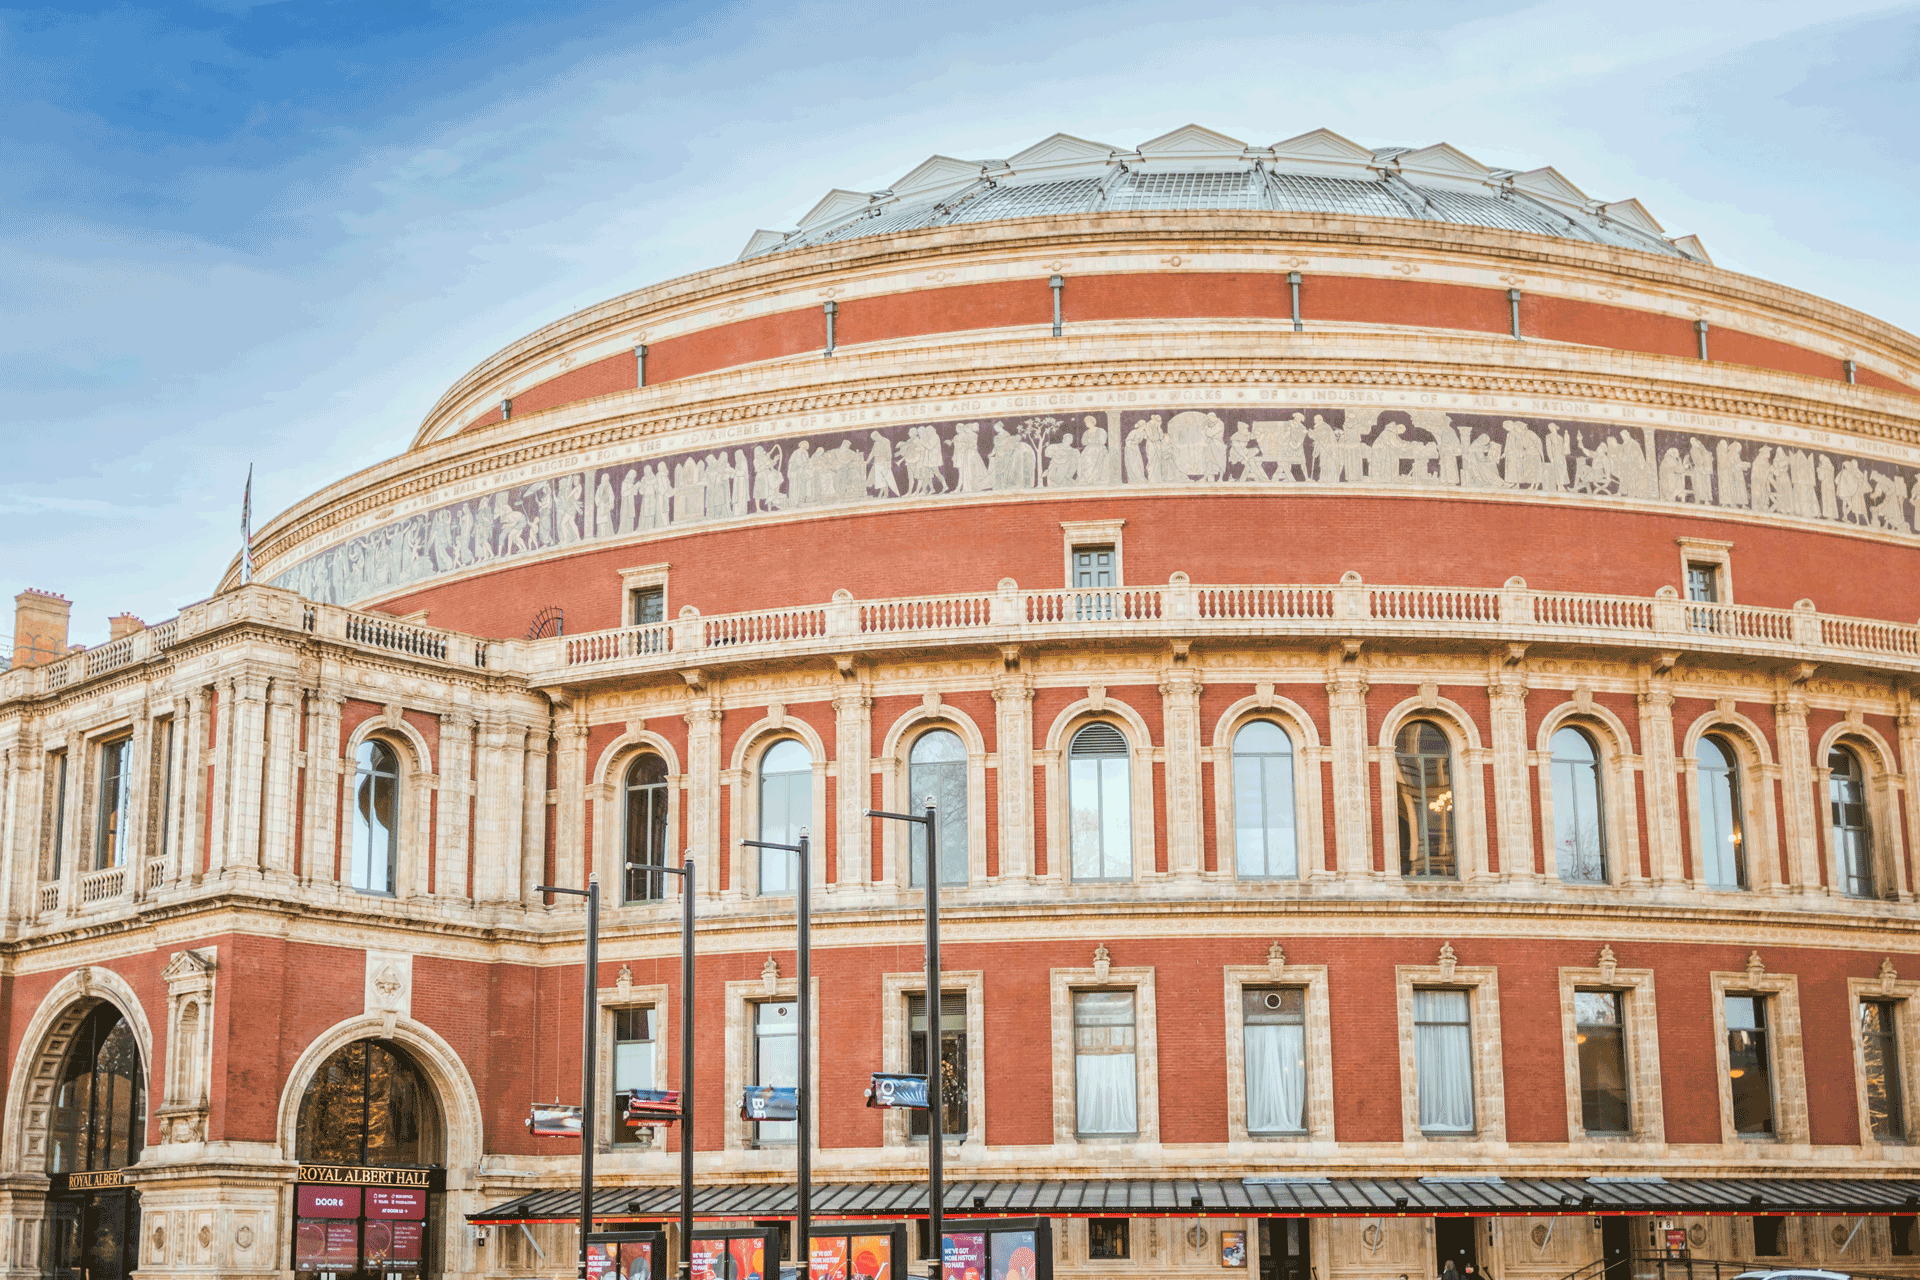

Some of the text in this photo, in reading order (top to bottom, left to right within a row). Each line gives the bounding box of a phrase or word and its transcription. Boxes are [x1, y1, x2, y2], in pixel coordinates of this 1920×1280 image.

[421, 390, 1909, 505] THIS HALL WAS ERECTED FOR THE ADVANCEMENT OF THE ARTS AND SCIENCES AND WORKS OF INDUSTRY OF ALL NATIONS IN FULFILMENT OF THE INTENTION
[333, 523, 353, 539] PEACE
[752, 1098, 766, 1119] BE
[69, 1173, 122, 1187] ROYAL ALBERT
[299, 1167, 429, 1185] ROYAL ALBERT HALL
[315, 1198, 337, 1206] DOOR
